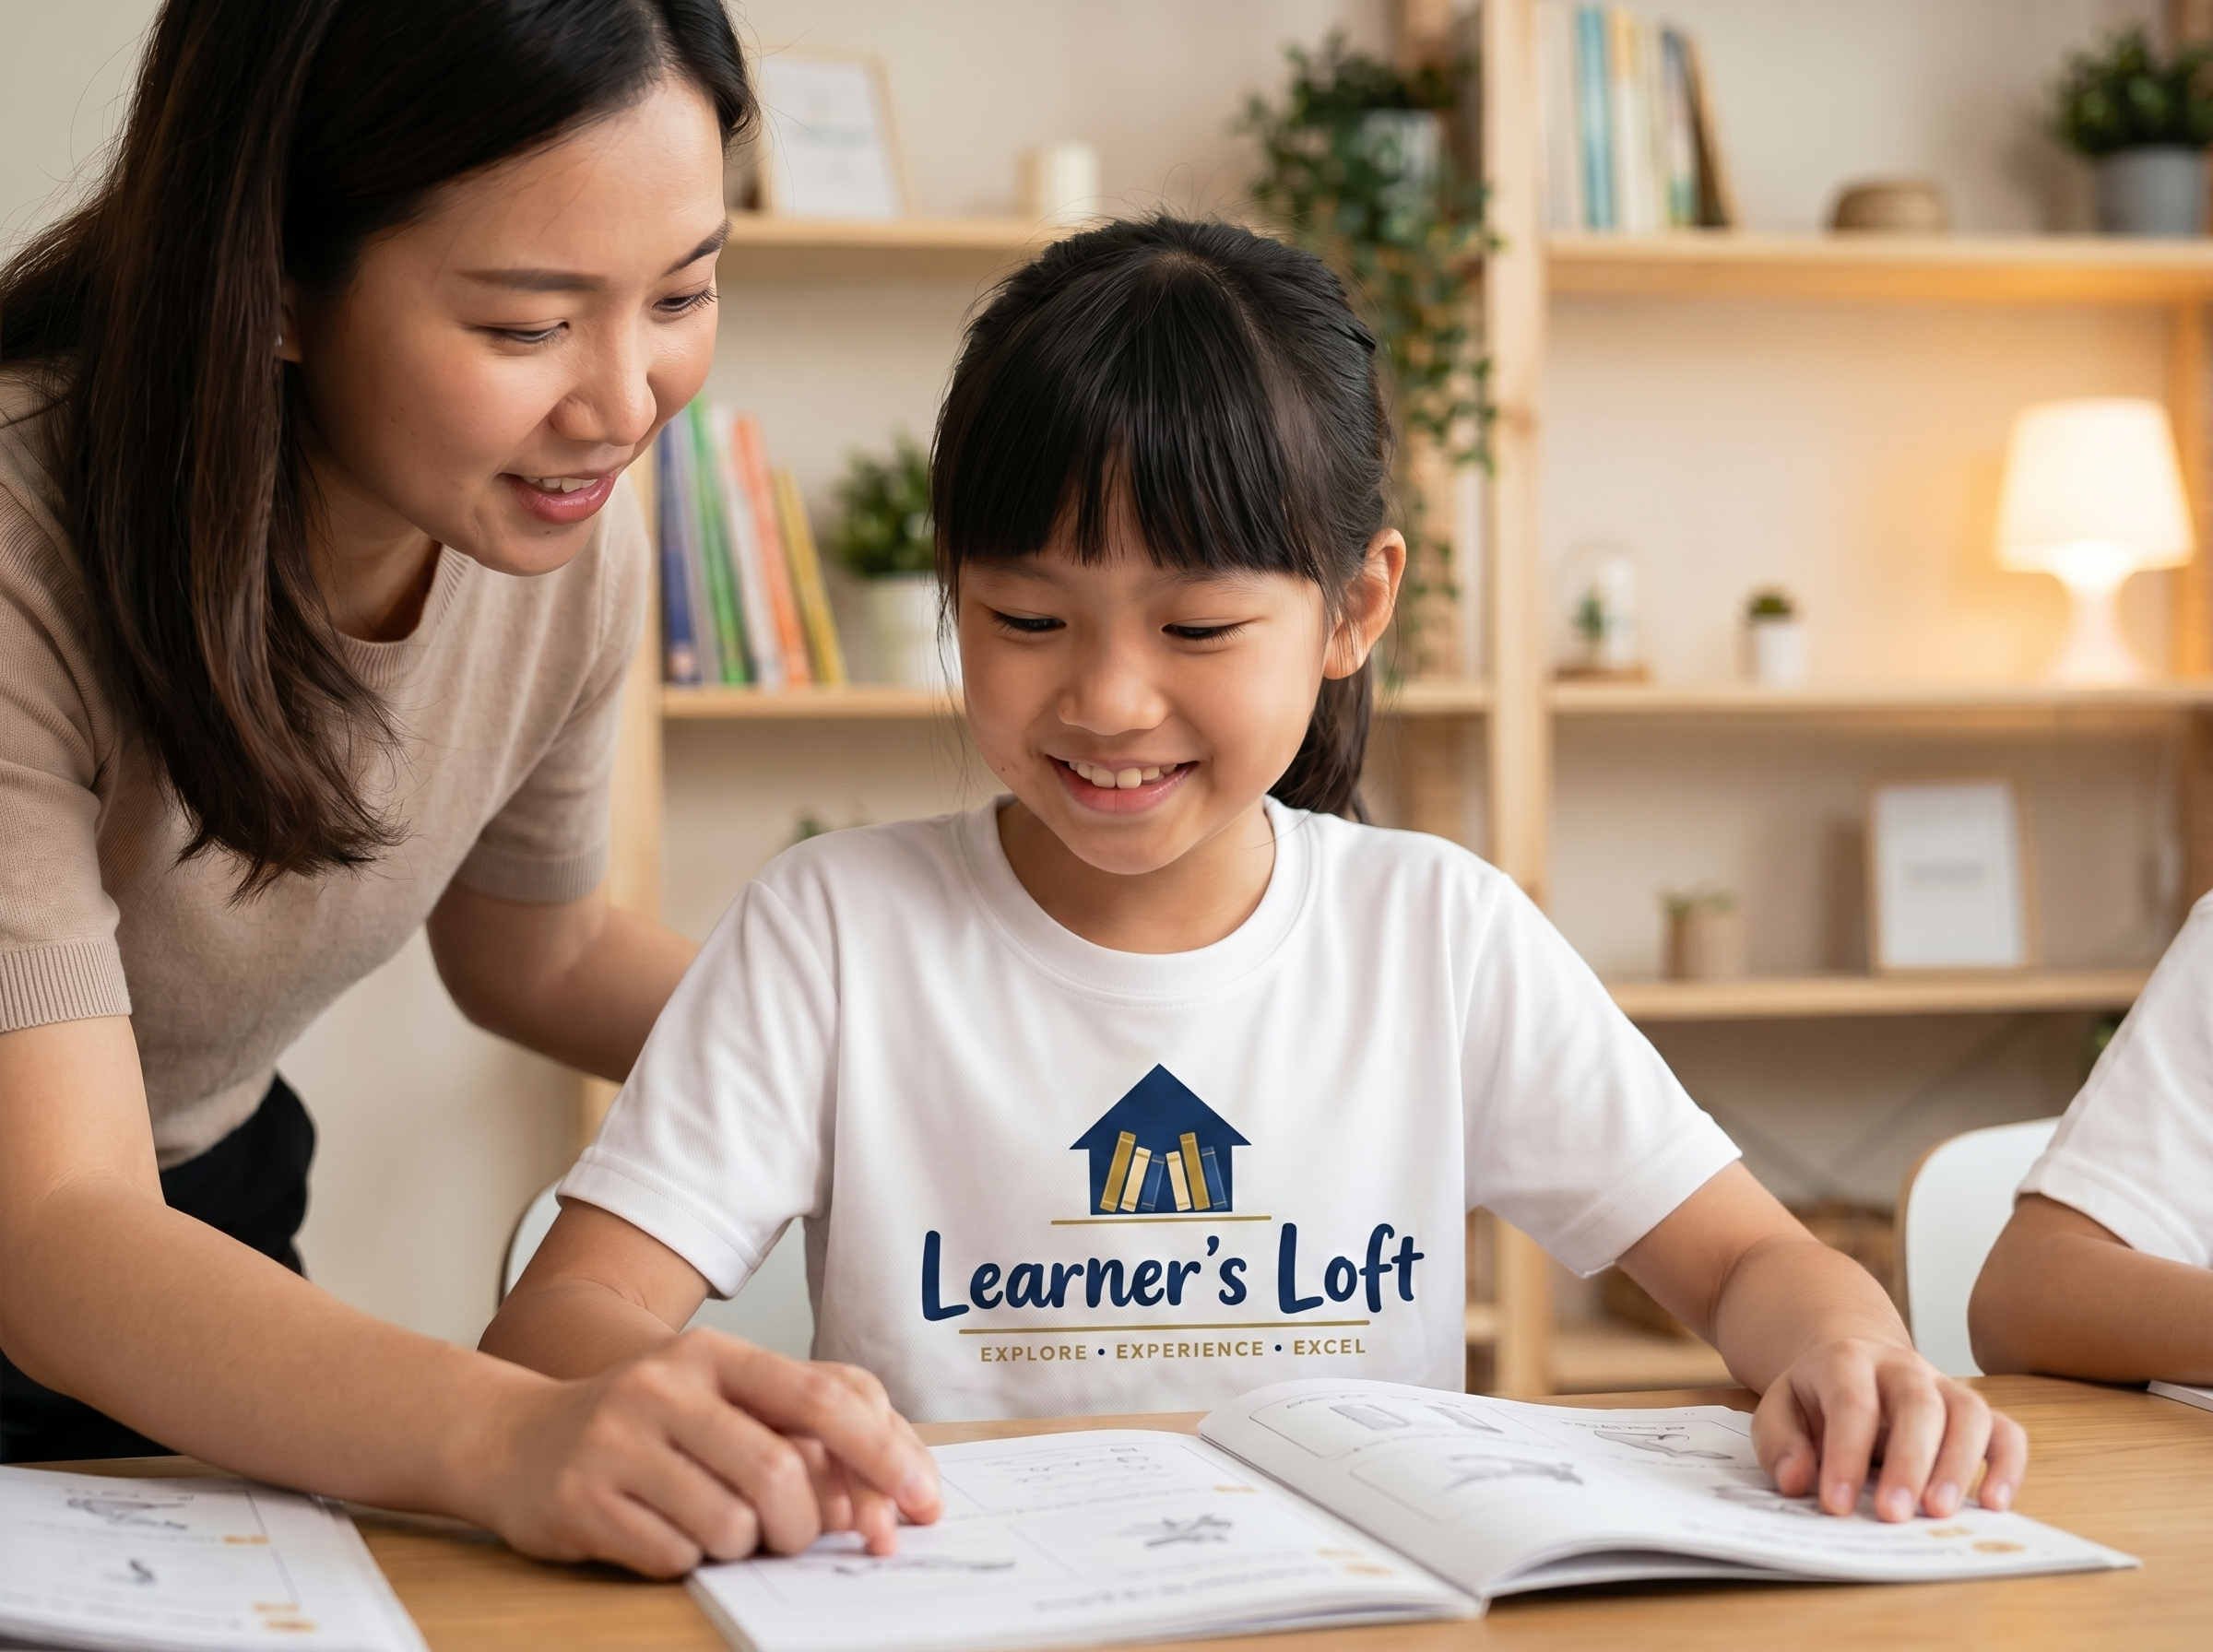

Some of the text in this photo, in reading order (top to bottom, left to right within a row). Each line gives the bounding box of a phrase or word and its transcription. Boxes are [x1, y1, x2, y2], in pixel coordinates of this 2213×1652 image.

[921, 1222, 1425, 1322] Learner's Loft
[980, 1339, 1366, 1363] EXPLORE EXPERIENCE EXCEL
